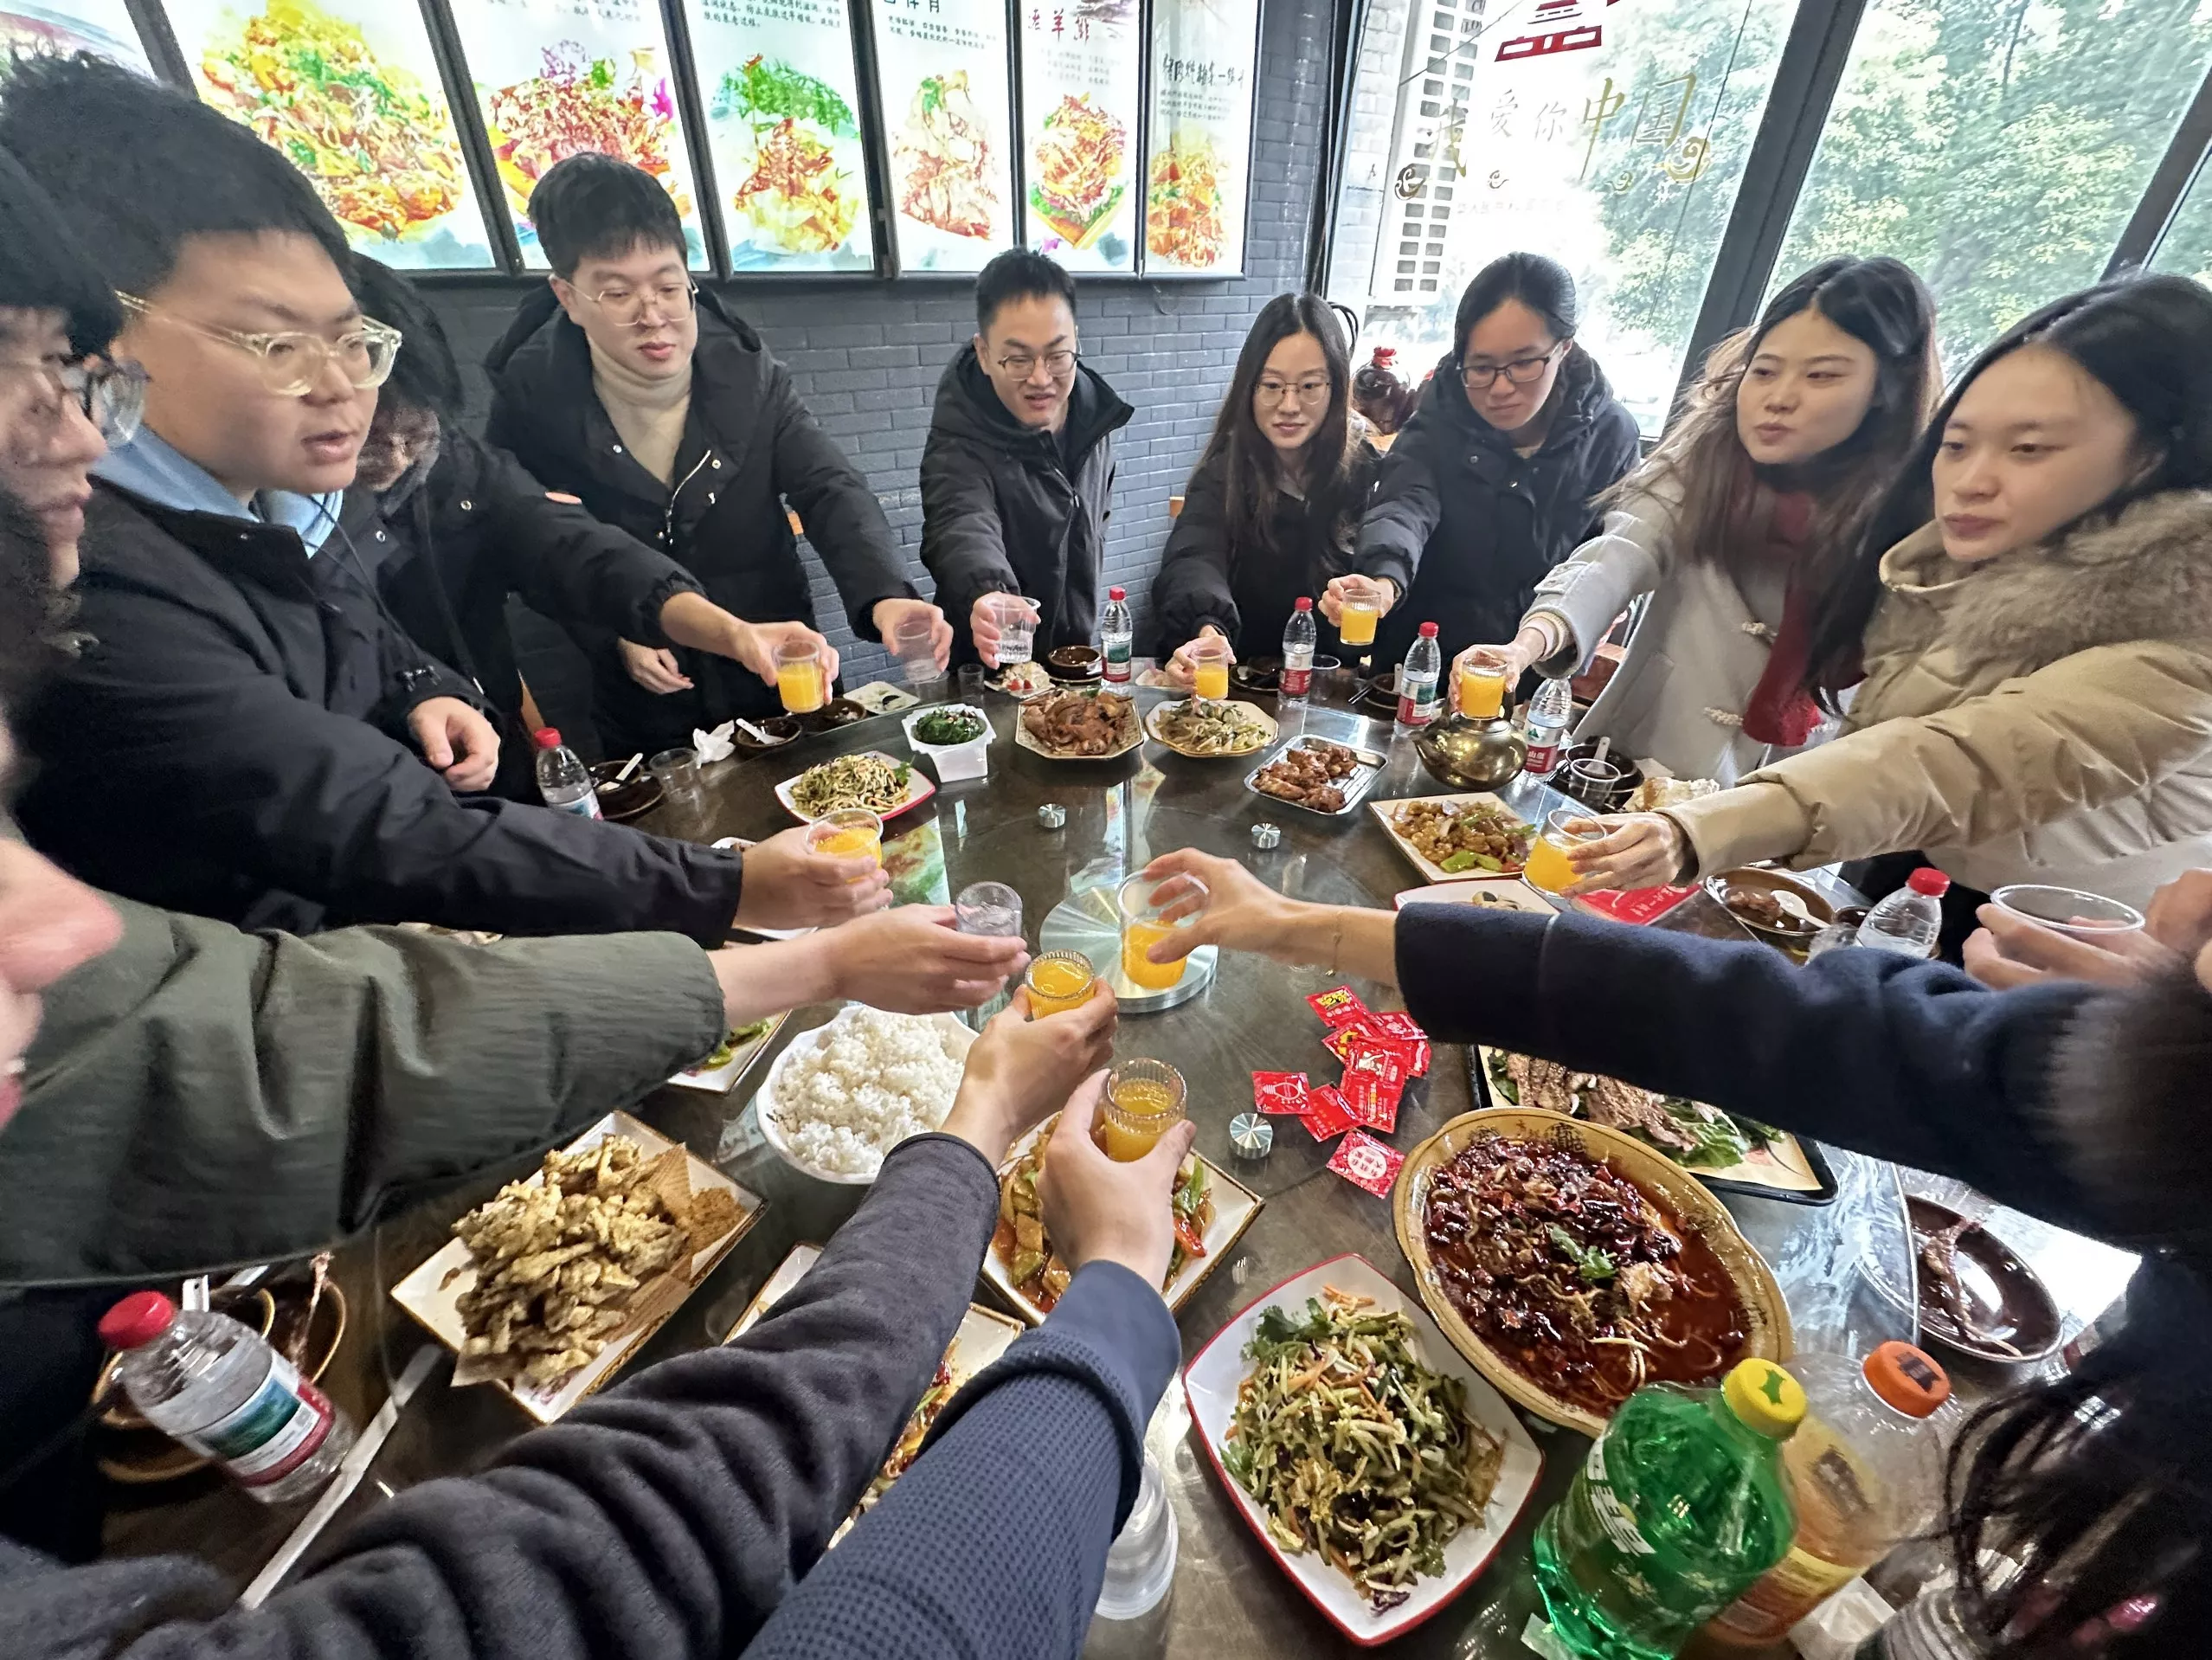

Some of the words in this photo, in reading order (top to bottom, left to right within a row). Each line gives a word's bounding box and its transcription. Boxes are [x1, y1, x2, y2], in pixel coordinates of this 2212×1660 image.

[1427, 72, 1696, 180] 我爱你中国
